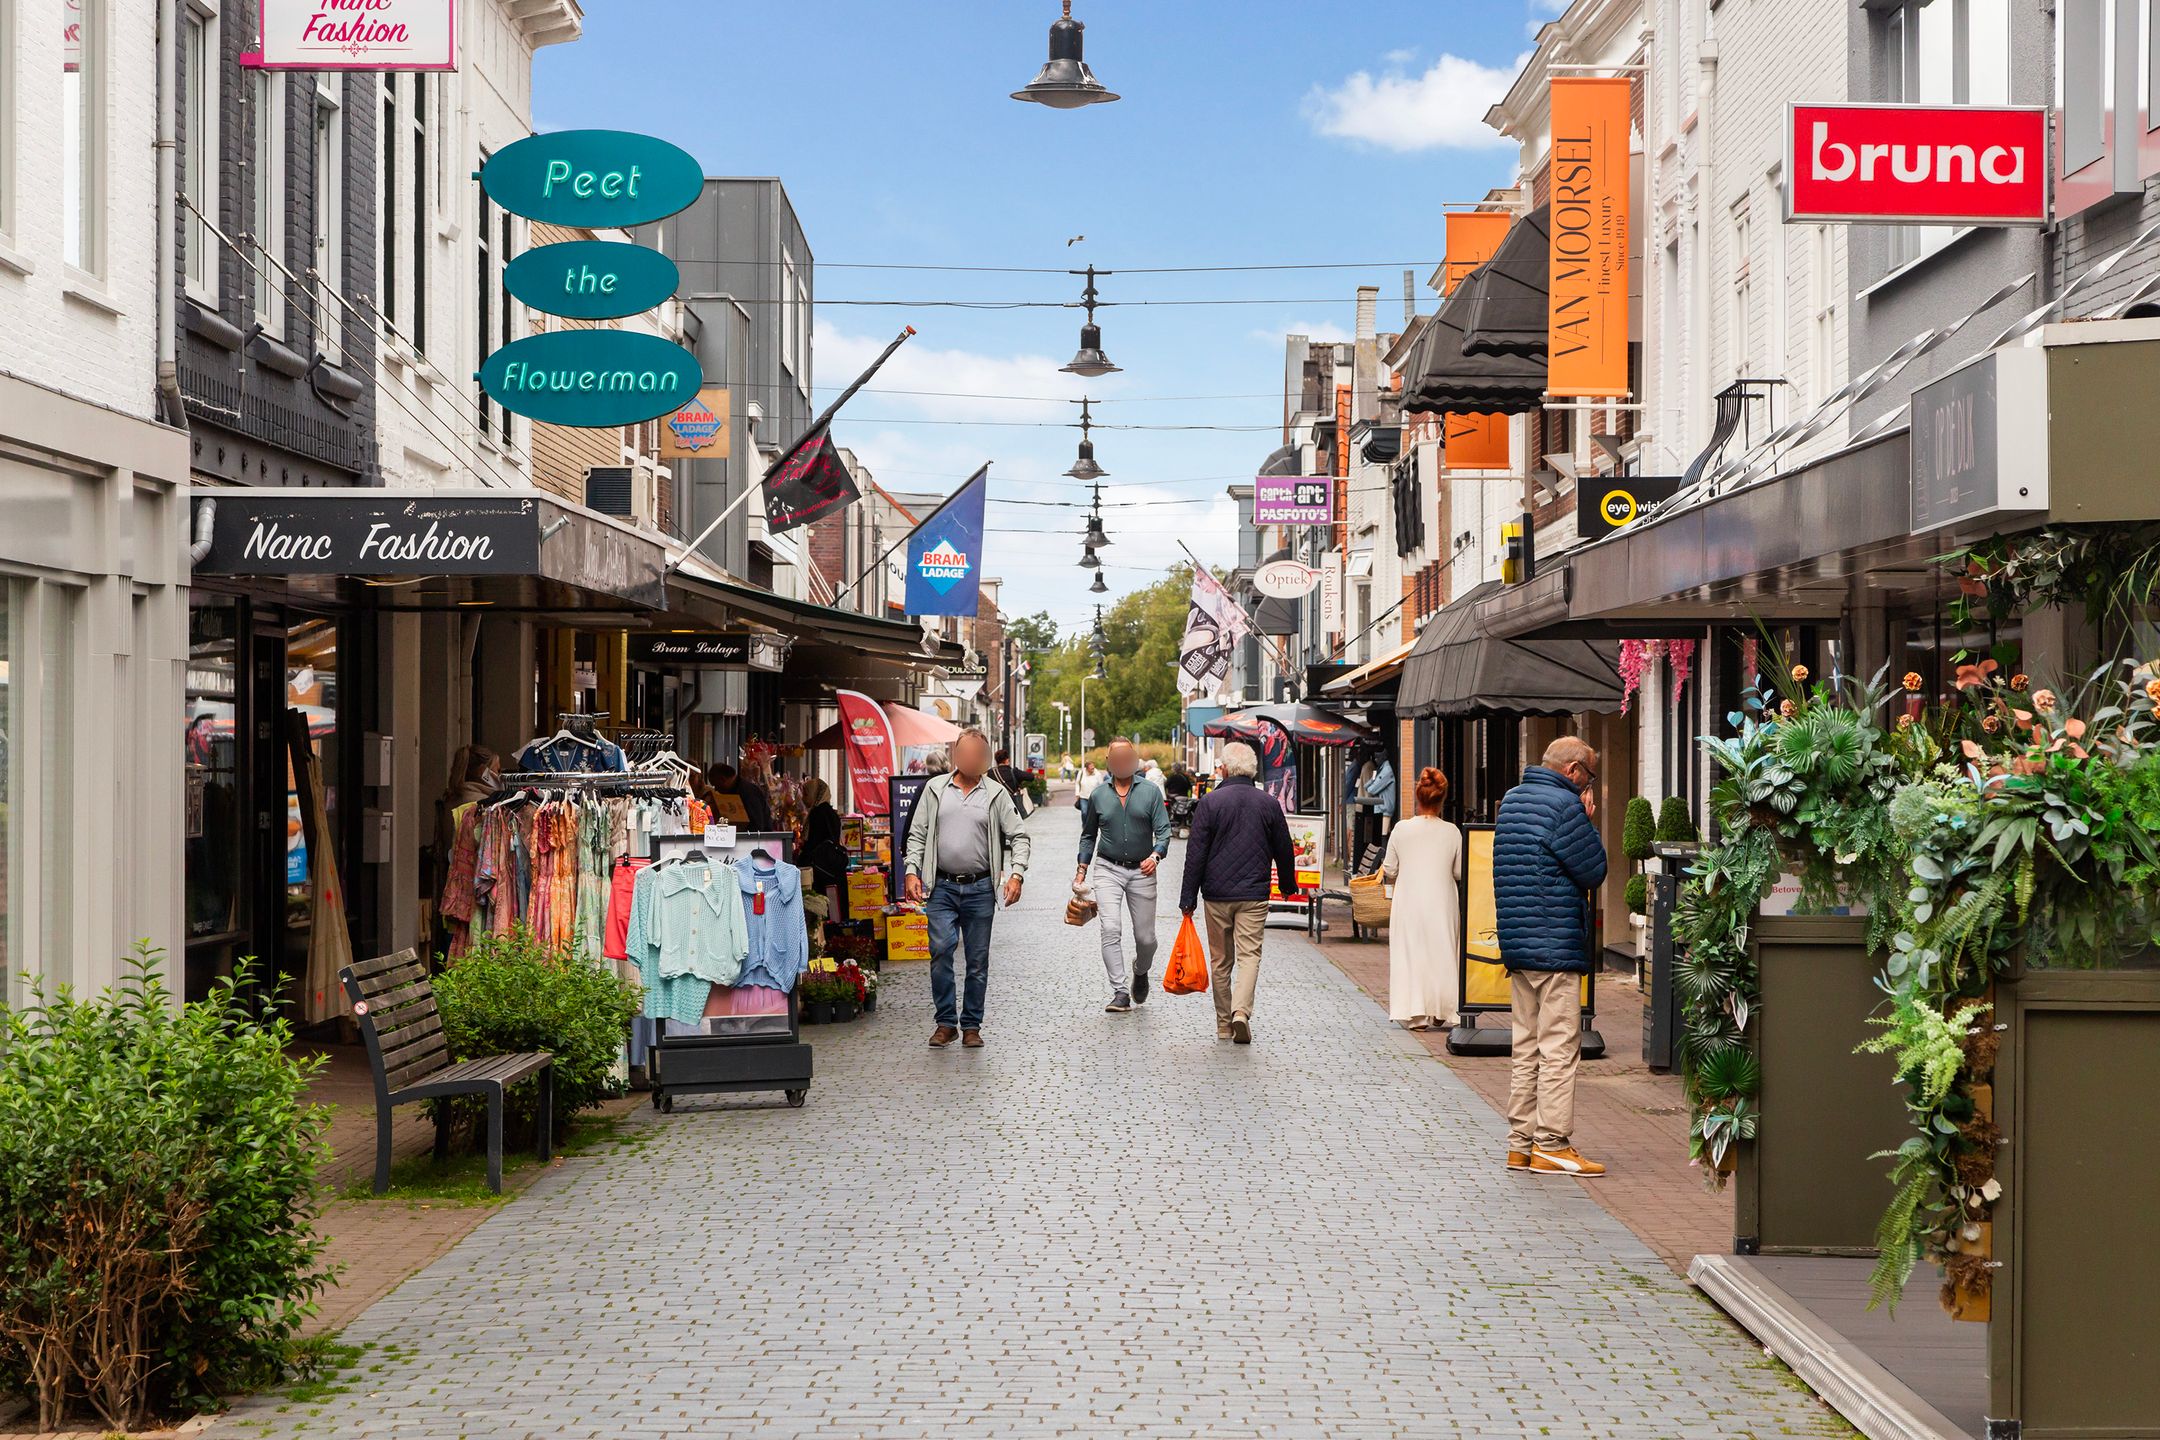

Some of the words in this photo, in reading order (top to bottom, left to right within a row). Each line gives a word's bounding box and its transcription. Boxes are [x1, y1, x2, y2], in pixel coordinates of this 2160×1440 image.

[303, 12, 409, 42] Fashion
[1812, 121, 2025, 185] bruna
[542, 159, 642, 199] Peet
[1555, 125, 1592, 282] MOORSEL
[1599, 195, 1616, 244] Luxury
[1616, 239, 1625, 271] Since
[564, 265, 618, 294] the
[1598, 247, 1611, 295] Finest
[1554, 295, 1590, 358] VAN
[676, 424, 715, 433] LADAGE
[677, 412, 714, 423] BRAM
[1259, 508, 1328, 521] PASFOTO'S
[1607, 503, 1630, 516] eye
[243, 522, 333, 560] Nanc
[359, 520, 494, 560] Fashion
[922, 567, 965, 579] LADAGE
[923, 552, 965, 567] BRAM
[1265, 571, 1308, 589] Optiek
[1324, 566, 1338, 620] Roukens
[651, 641, 690, 653] Bram
[695, 641, 741, 658] Ladage
